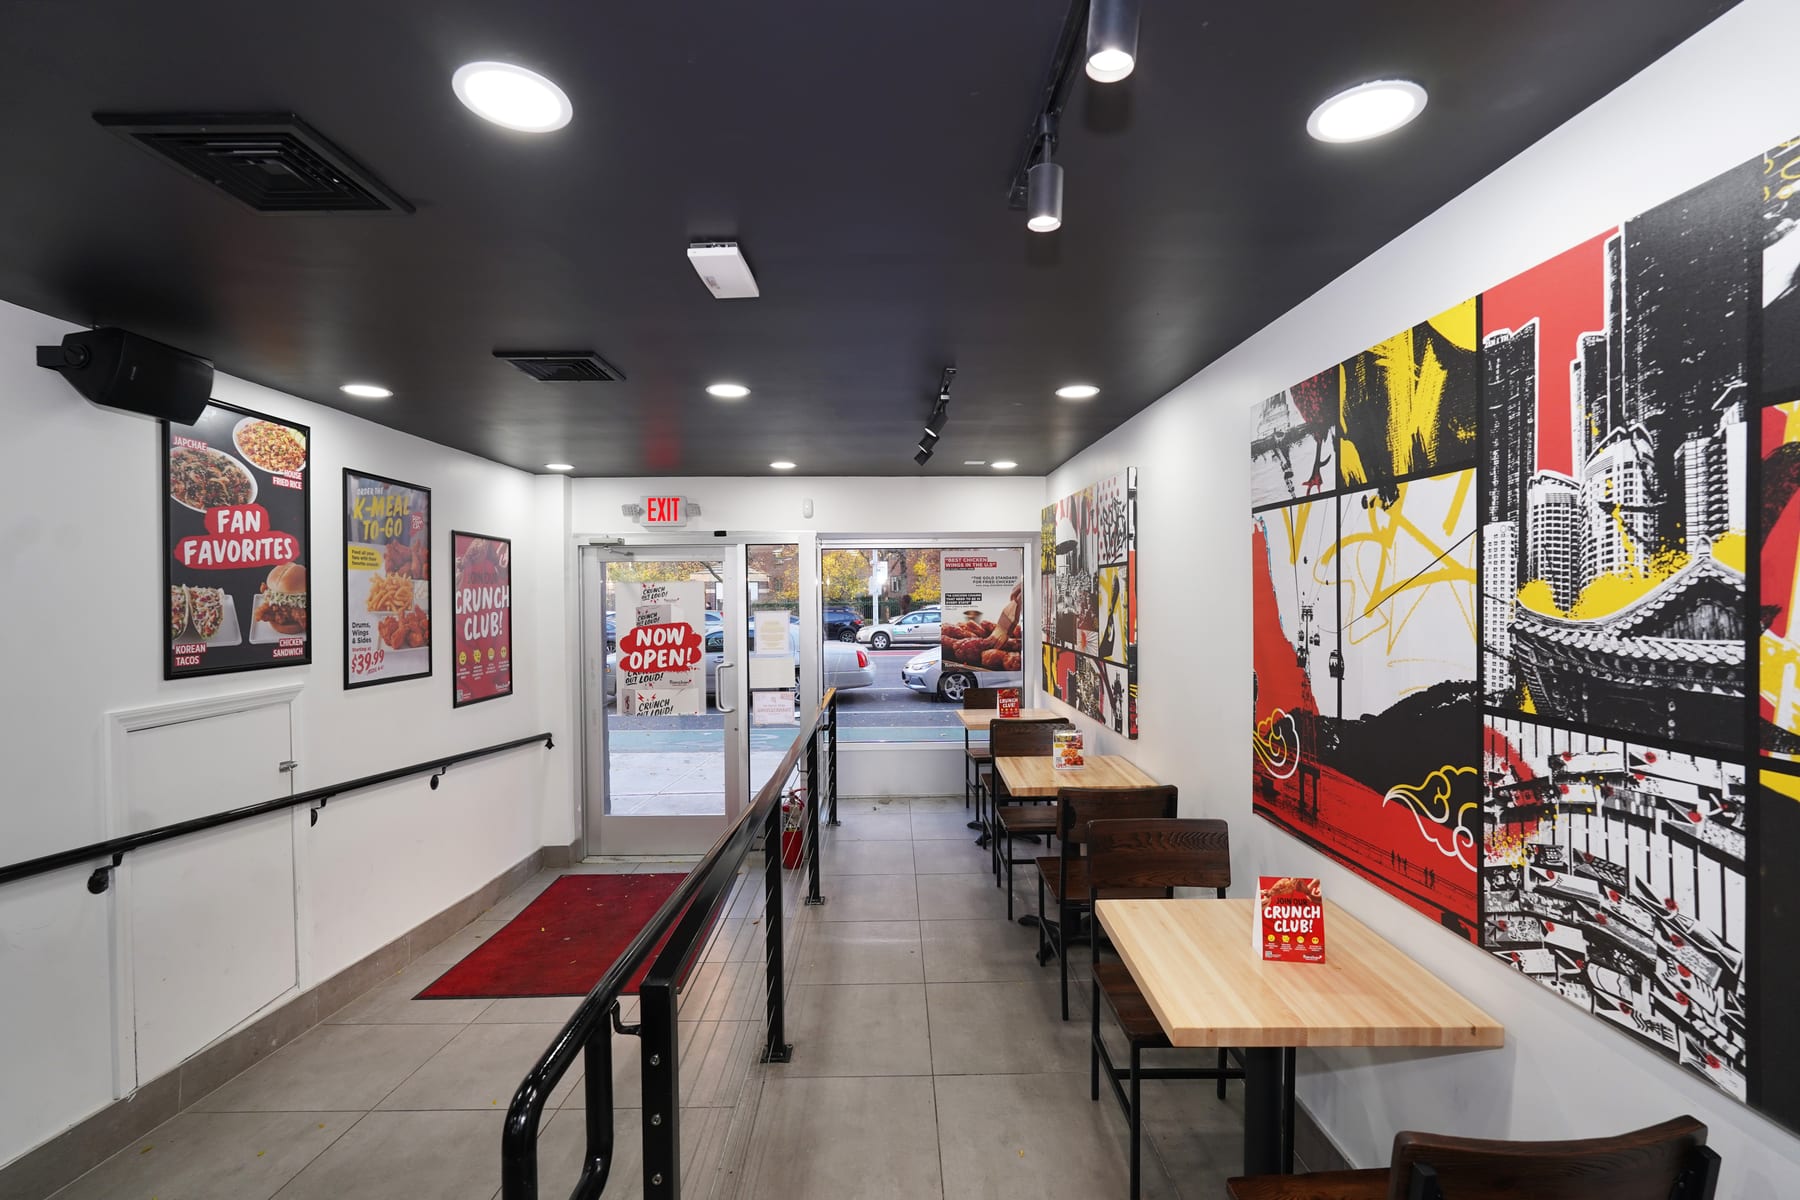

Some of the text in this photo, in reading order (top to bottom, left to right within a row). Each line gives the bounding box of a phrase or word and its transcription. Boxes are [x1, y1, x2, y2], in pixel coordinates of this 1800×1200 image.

[173, 436, 207, 451] JAPCHAE
[284, 471, 302, 480] HOUSE
[272, 477, 302, 489] FRIED RICE
[353, 495, 410, 520] K-MEAL
[647, 497, 680, 522] EXIT
[217, 509, 261, 534] FAN
[362, 517, 403, 541] TO-GO
[183, 537, 293, 566] FAVORITES
[642, 587, 666, 596] CRUNCH
[651, 591, 669, 600] LOUD!
[456, 585, 509, 615] CRUNCH
[637, 612, 657, 621] CRUNCH
[644, 616, 660, 626] LOUD!
[464, 611, 503, 641] CLUB!
[357, 636, 371, 644] Sides
[636, 625, 685, 646] NOW
[175, 644, 206, 654] KOREAN
[280, 639, 303, 647] CHICKEN
[272, 648, 303, 658] SANDWICH
[629, 647, 692, 670] OPEN!
[176, 656, 200, 666] TACOS
[351, 649, 385, 675] $39.99
[625, 676, 637, 686] OUT
[639, 672, 664, 684] LOUD!
[638, 699, 670, 712] CRUNCH
[650, 705, 674, 717] LOUD!
[1276, 897, 1307, 906] JOIN OUR
[1264, 906, 1320, 918] CRUNCH
[1274, 920, 1313, 933] CLUB!
